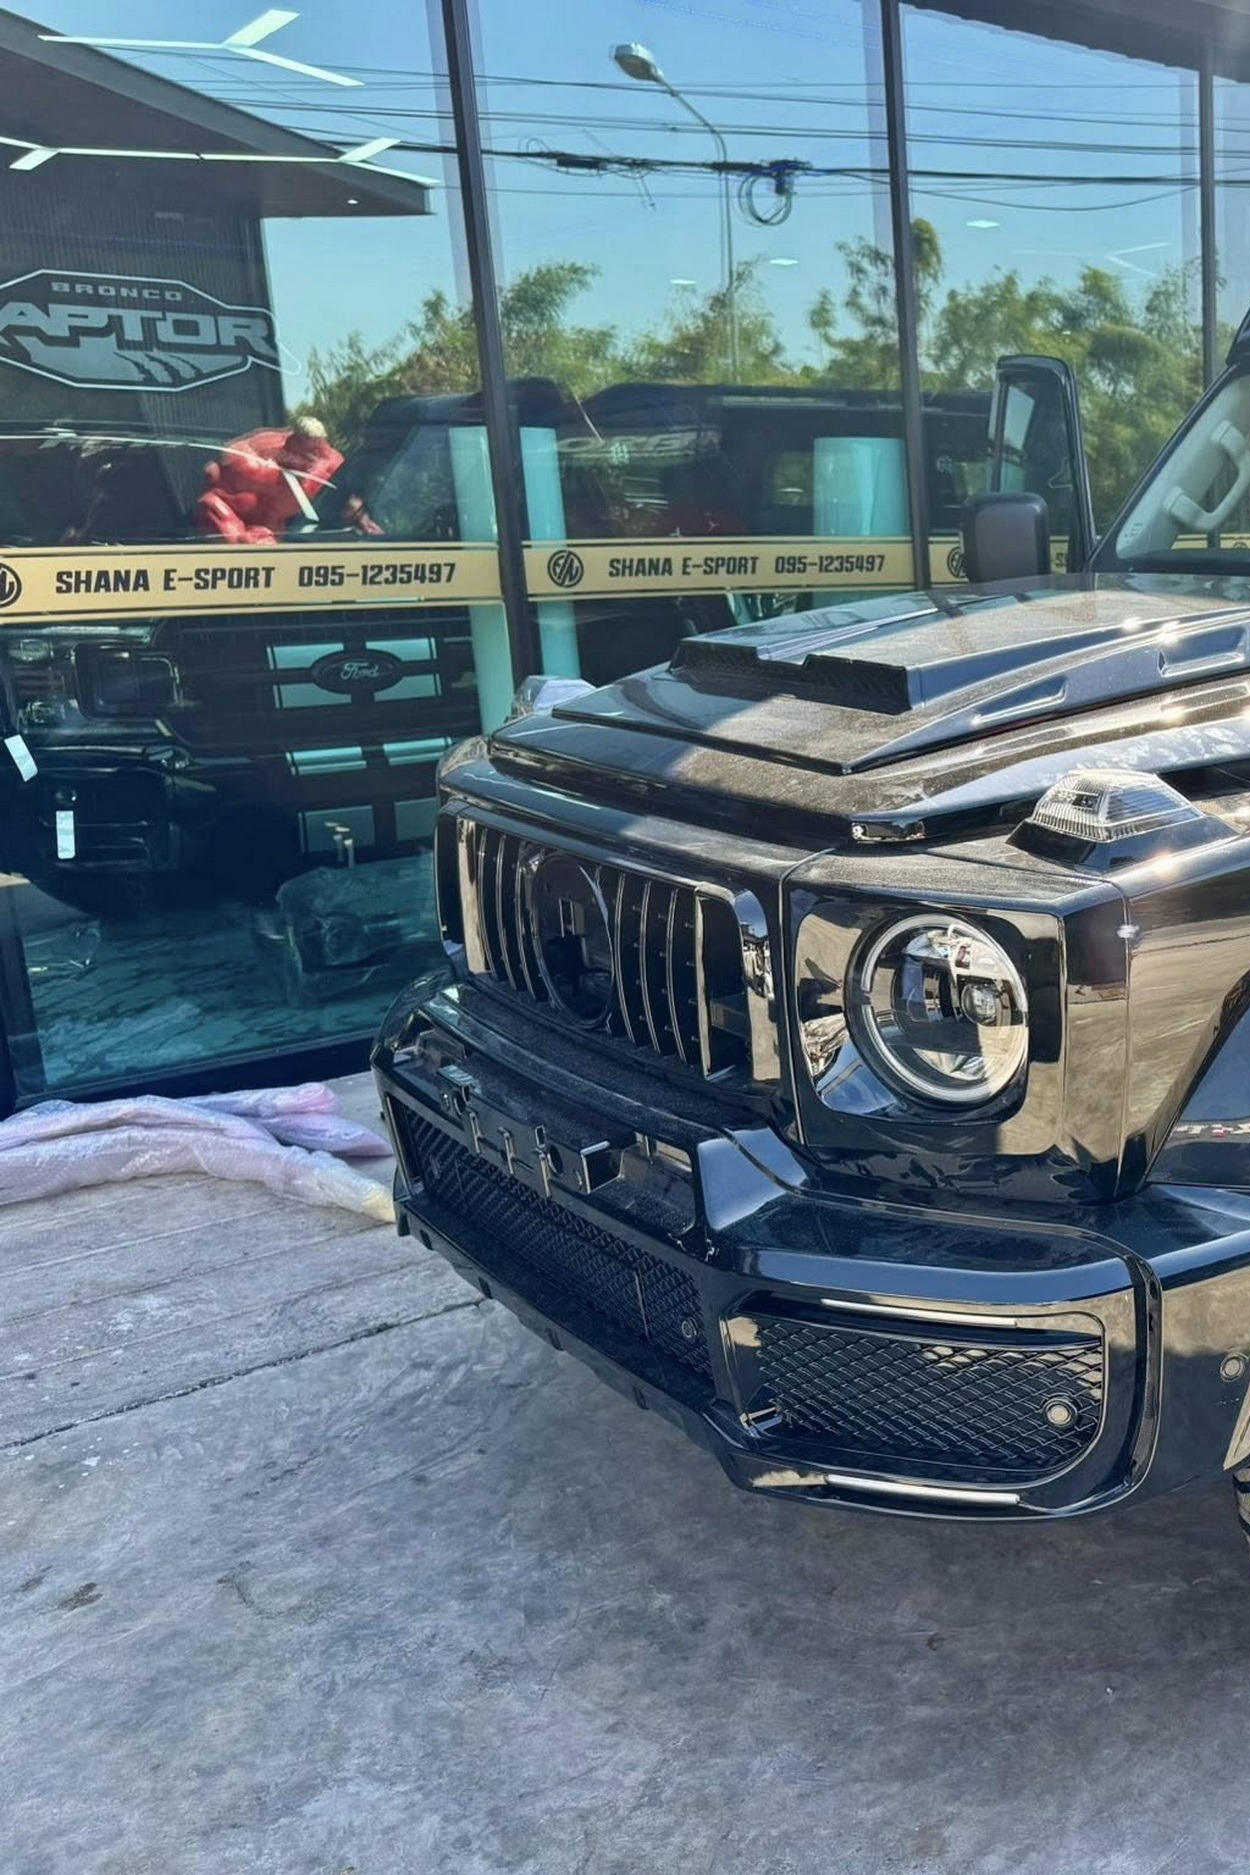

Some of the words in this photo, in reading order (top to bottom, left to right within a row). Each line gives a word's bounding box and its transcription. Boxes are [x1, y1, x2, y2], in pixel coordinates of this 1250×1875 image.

[51, 281, 182, 301] BRONCO
[0, 301, 278, 358] APTOR
[608, 557, 673, 577] SHANA
[681, 556, 760, 575] E-SPORT
[774, 554, 886, 574] 095-1235497
[55, 569, 150, 594] SHANA
[163, 566, 276, 591] E-SPORT
[298, 562, 456, 587] 095-1235497
[340, 661, 380, 680] Ford
